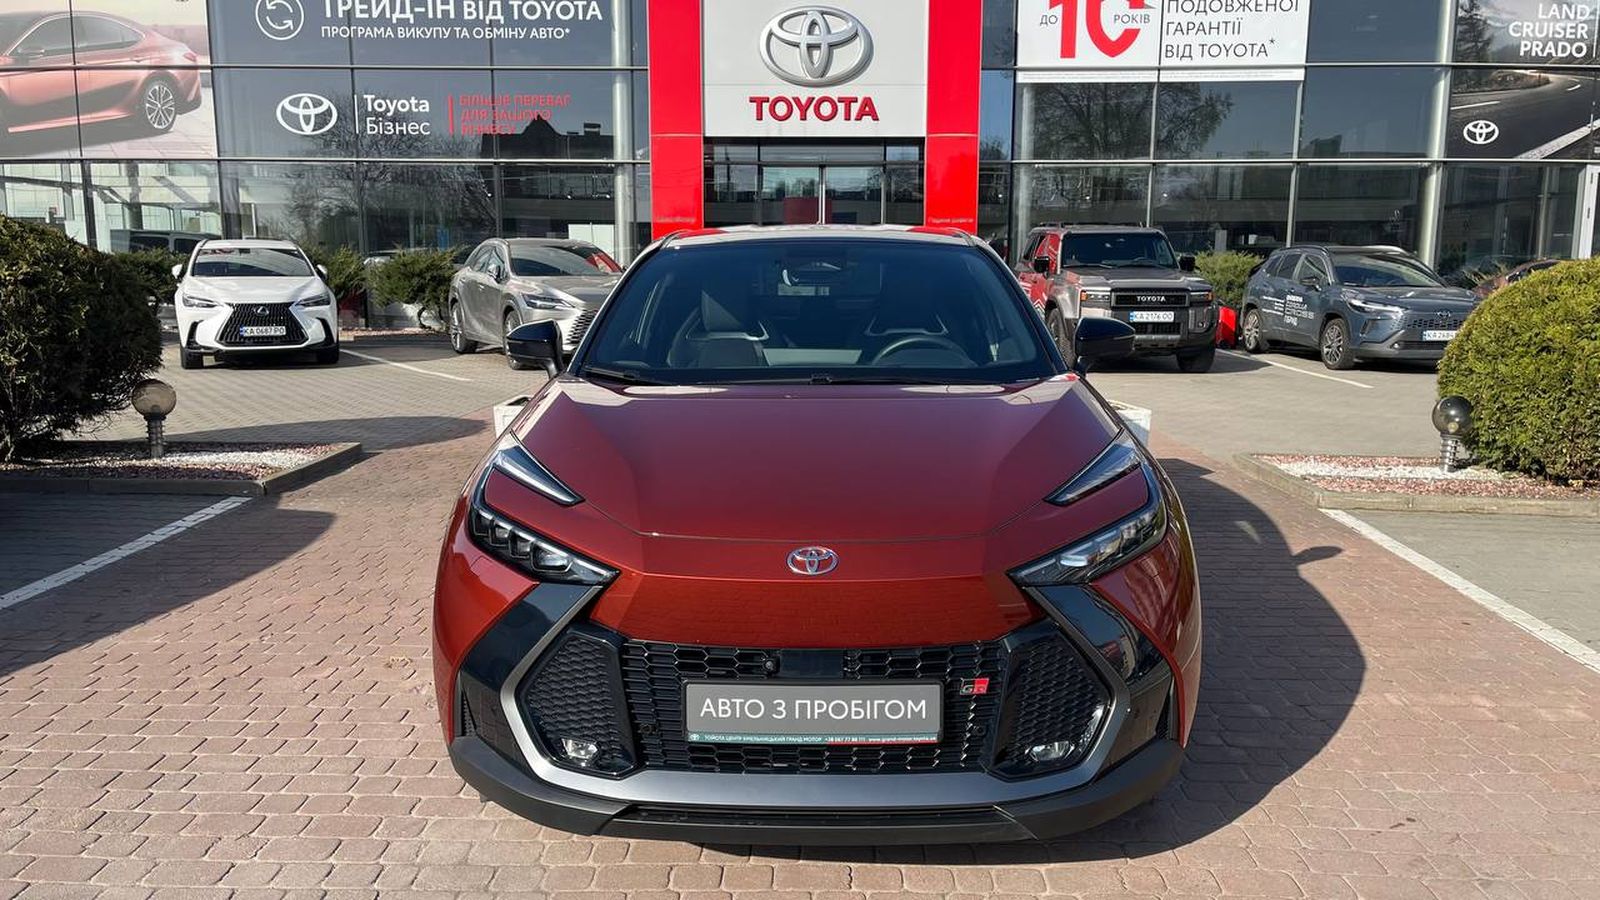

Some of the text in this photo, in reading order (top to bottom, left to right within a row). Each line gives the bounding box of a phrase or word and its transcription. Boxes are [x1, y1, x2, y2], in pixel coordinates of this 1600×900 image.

[463, 0, 504, 24] ВІД
[508, 0, 603, 20] TOYOTA
[1040, 14, 1058, 26] ДО
[1113, 14, 1151, 24] РОКІВ
[1538, 3, 1590, 20] LAND
[321, 26, 394, 38] ПРОГРАМА
[397, 27, 451, 39] ВИКУПУ
[453, 27, 470, 39] ТА
[472, 27, 527, 39] ОБМІНУ
[1166, 17, 1243, 35] ГАРАНТІЇ
[1508, 21, 1588, 39] CRUISER
[1165, 44, 1193, 60] ВІД
[1519, 40, 1587, 58] PRADO
[363, 94, 430, 116] Toyota
[514, 94, 572, 107] ПЕРЕВАГ
[748, 95, 880, 122] TOYOTA
[366, 117, 431, 135] Бізнес
[700, 698, 927, 720] АВТО З ПРОБІГОМ
